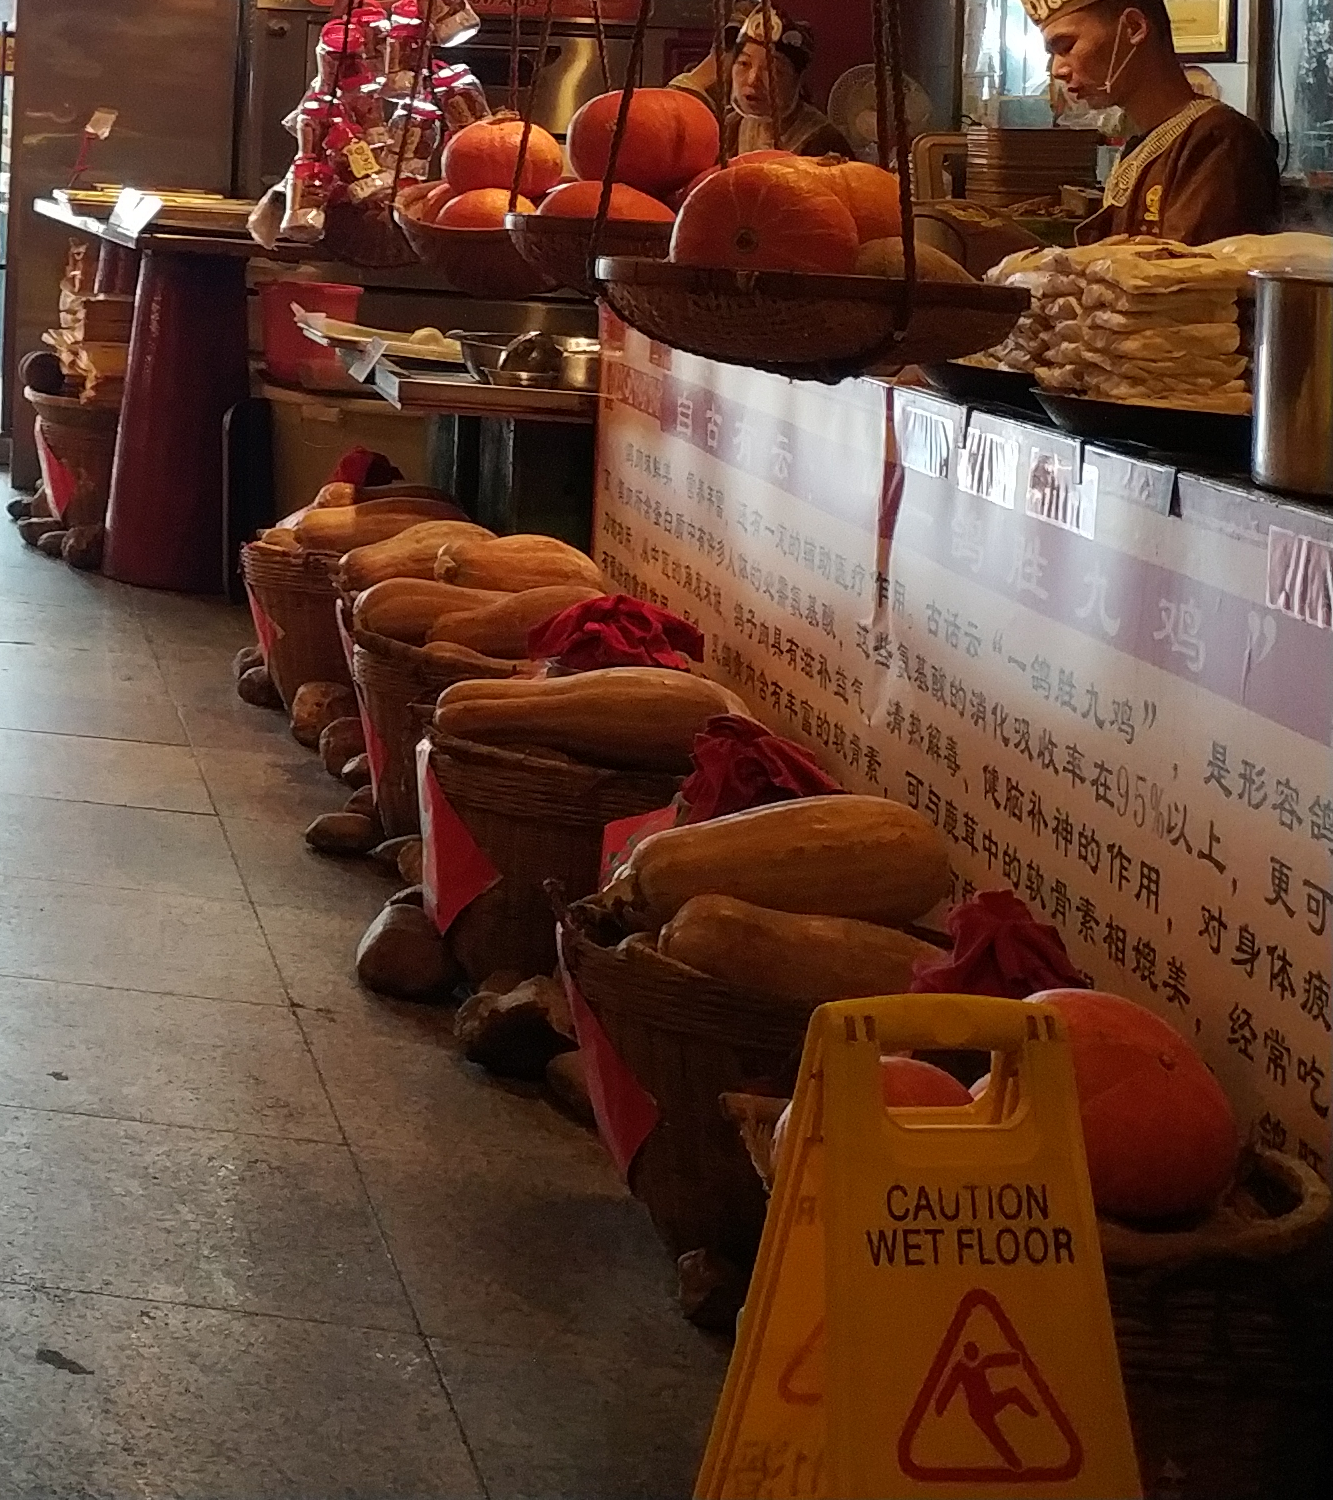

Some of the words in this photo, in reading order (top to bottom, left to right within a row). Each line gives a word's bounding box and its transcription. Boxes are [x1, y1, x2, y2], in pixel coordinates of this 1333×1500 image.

[886, 1184, 1049, 1221] CAUTION
[866, 1229, 945, 1266] WET
[955, 1229, 1076, 1266] FLOOR
